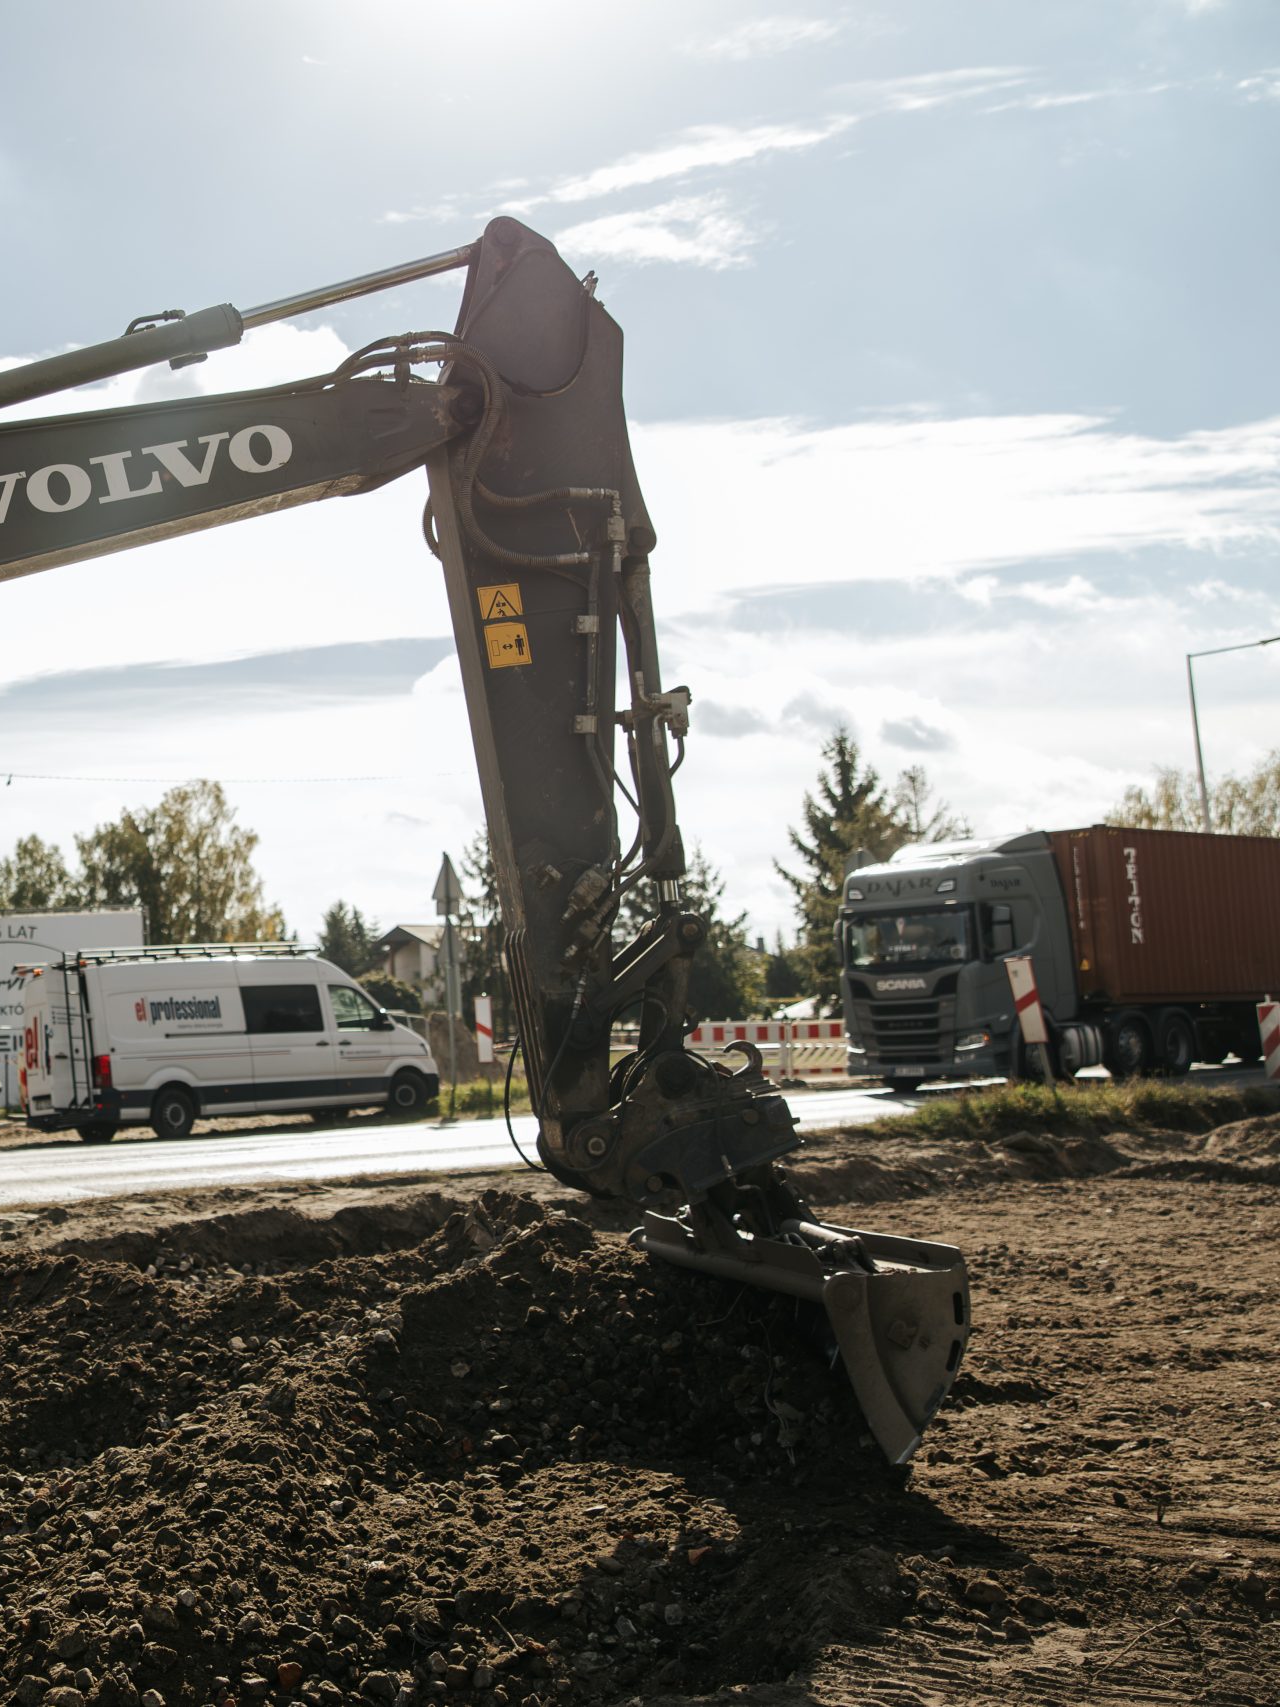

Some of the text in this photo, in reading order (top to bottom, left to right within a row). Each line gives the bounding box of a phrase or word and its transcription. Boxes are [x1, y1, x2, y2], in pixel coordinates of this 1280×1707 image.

[867, 877, 933, 897] DAJAR
[990, 879, 1021, 890] DAJAR
[1123, 846, 1144, 944] TRITON
[7, 925, 38, 940] LAT
[876, 978, 926, 991] SCANIA
[135, 995, 222, 1025] el professional
